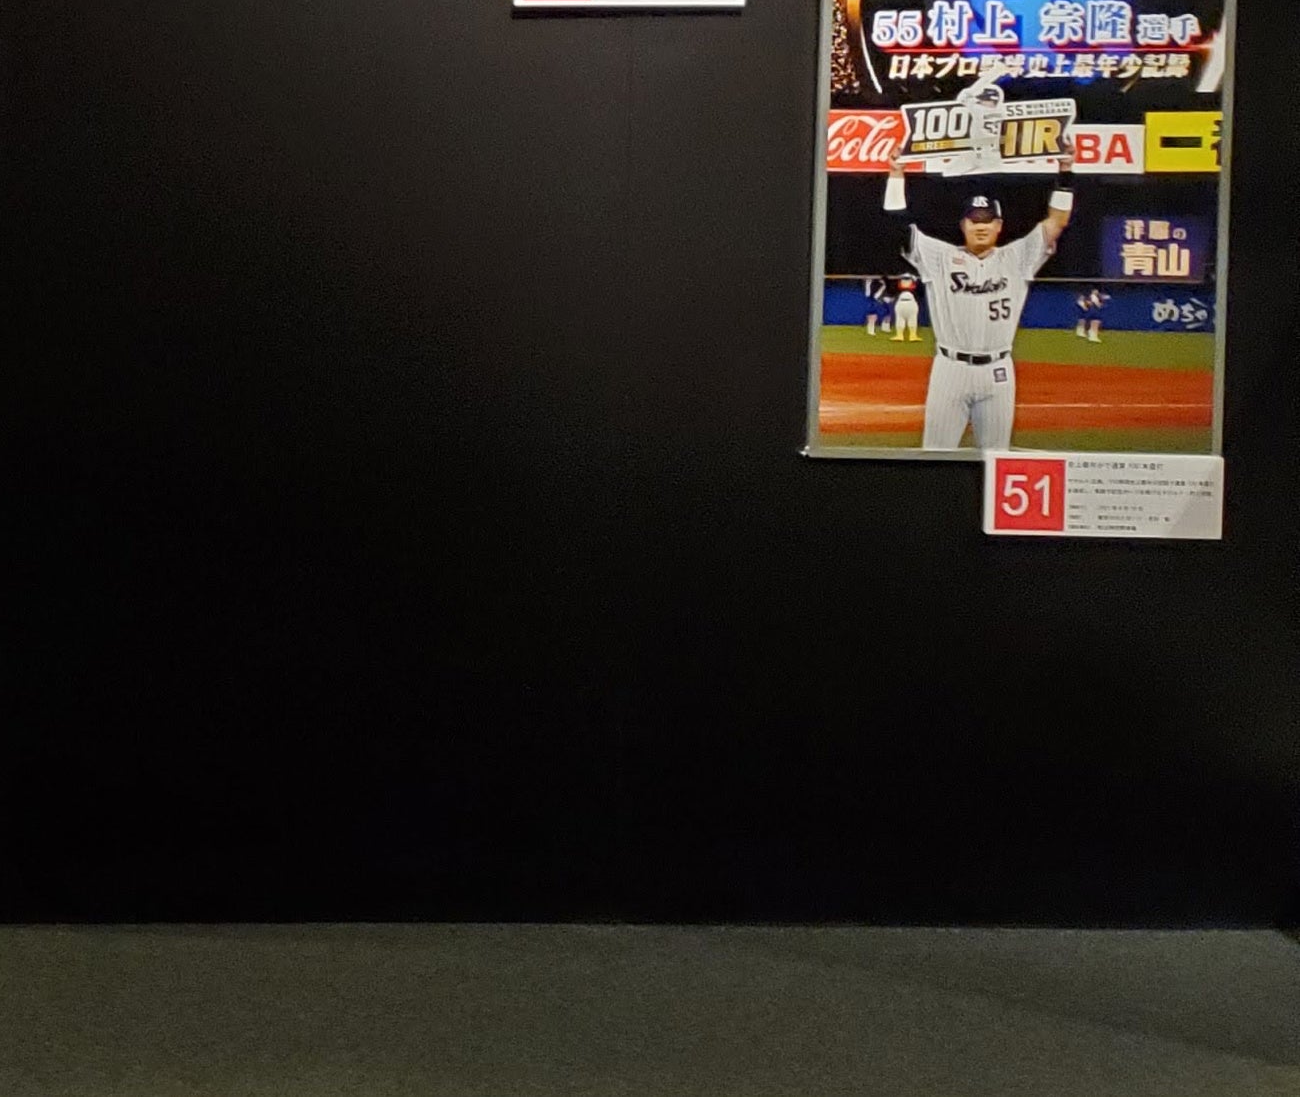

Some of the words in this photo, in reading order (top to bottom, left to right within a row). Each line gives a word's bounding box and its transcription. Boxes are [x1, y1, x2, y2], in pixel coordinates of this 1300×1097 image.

[889, 52, 1191, 80] 日本プロ野球史上最年少記録
[912, 106, 969, 142] 100
[1006, 104, 1024, 117] 55
[1120, 242, 1190, 276] 青山
[988, 298, 1011, 321] 55
[1001, 474, 1051, 517] 51
